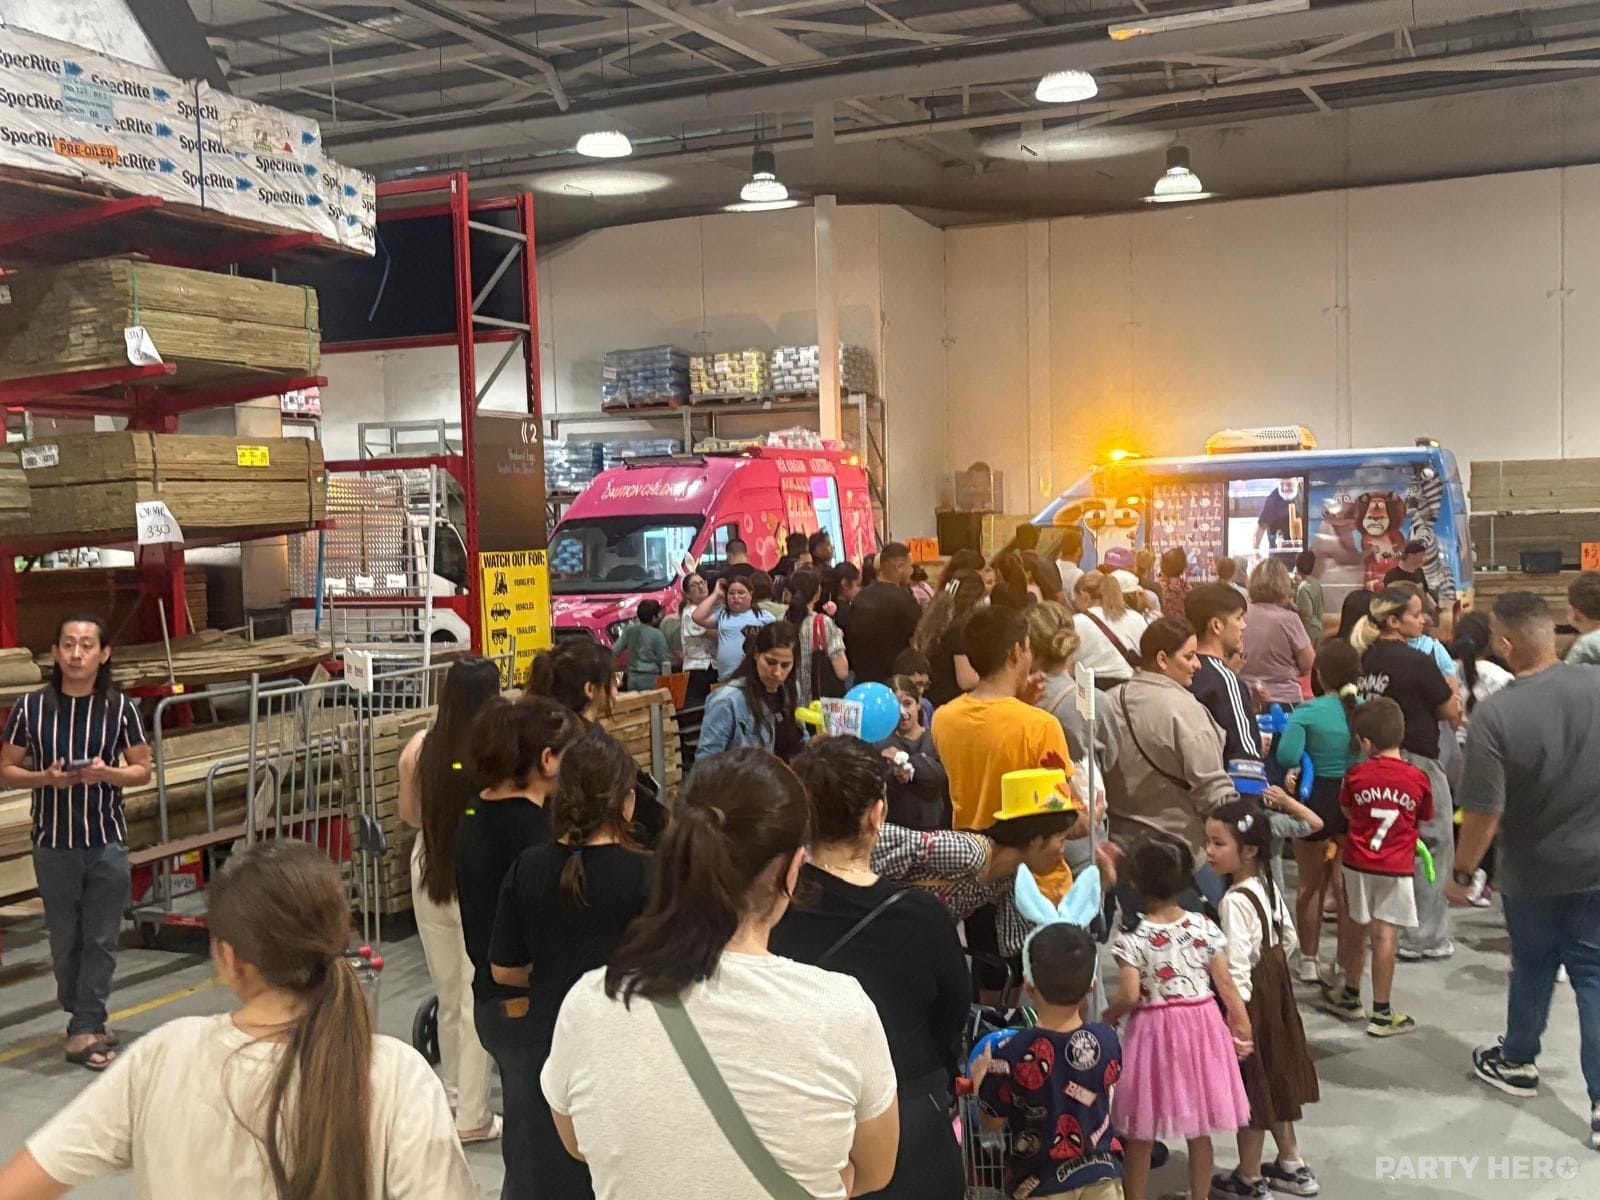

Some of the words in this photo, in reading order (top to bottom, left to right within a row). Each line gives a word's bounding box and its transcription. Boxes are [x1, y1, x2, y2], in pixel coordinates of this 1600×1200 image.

[182, 169, 234, 190] SpecRite
[530, 423, 538, 443] 2
[483, 553, 510, 569] WATCH
[512, 553, 526, 568] OUT
[528, 550, 545, 567] FOR:
[1354, 786, 1417, 812] RONALDO
[1370, 807, 1400, 851] 7
